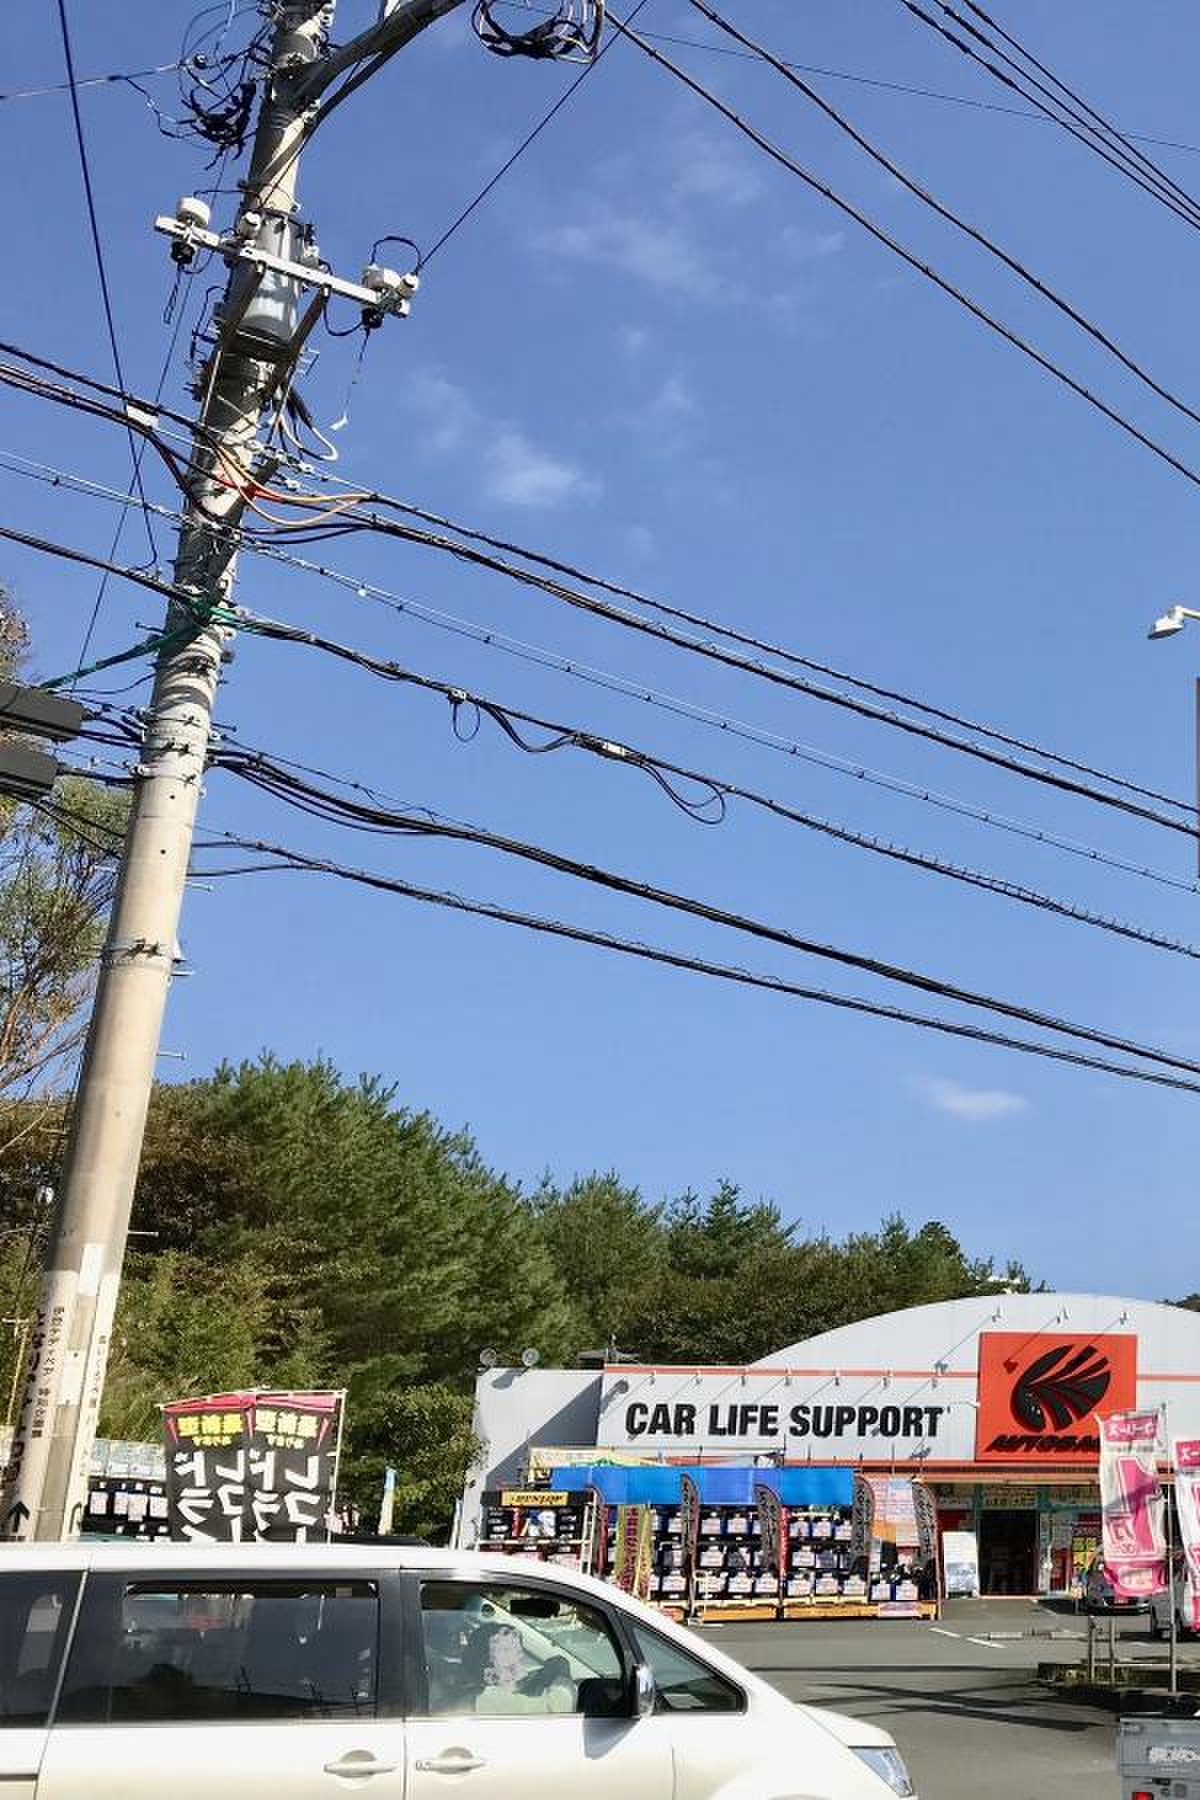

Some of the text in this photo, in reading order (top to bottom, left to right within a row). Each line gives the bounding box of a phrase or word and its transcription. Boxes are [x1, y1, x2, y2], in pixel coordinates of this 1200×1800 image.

[625, 1402, 943, 1437] CAR LIFE SUPPORT
[985, 1433, 1101, 1453] AUTOBA
